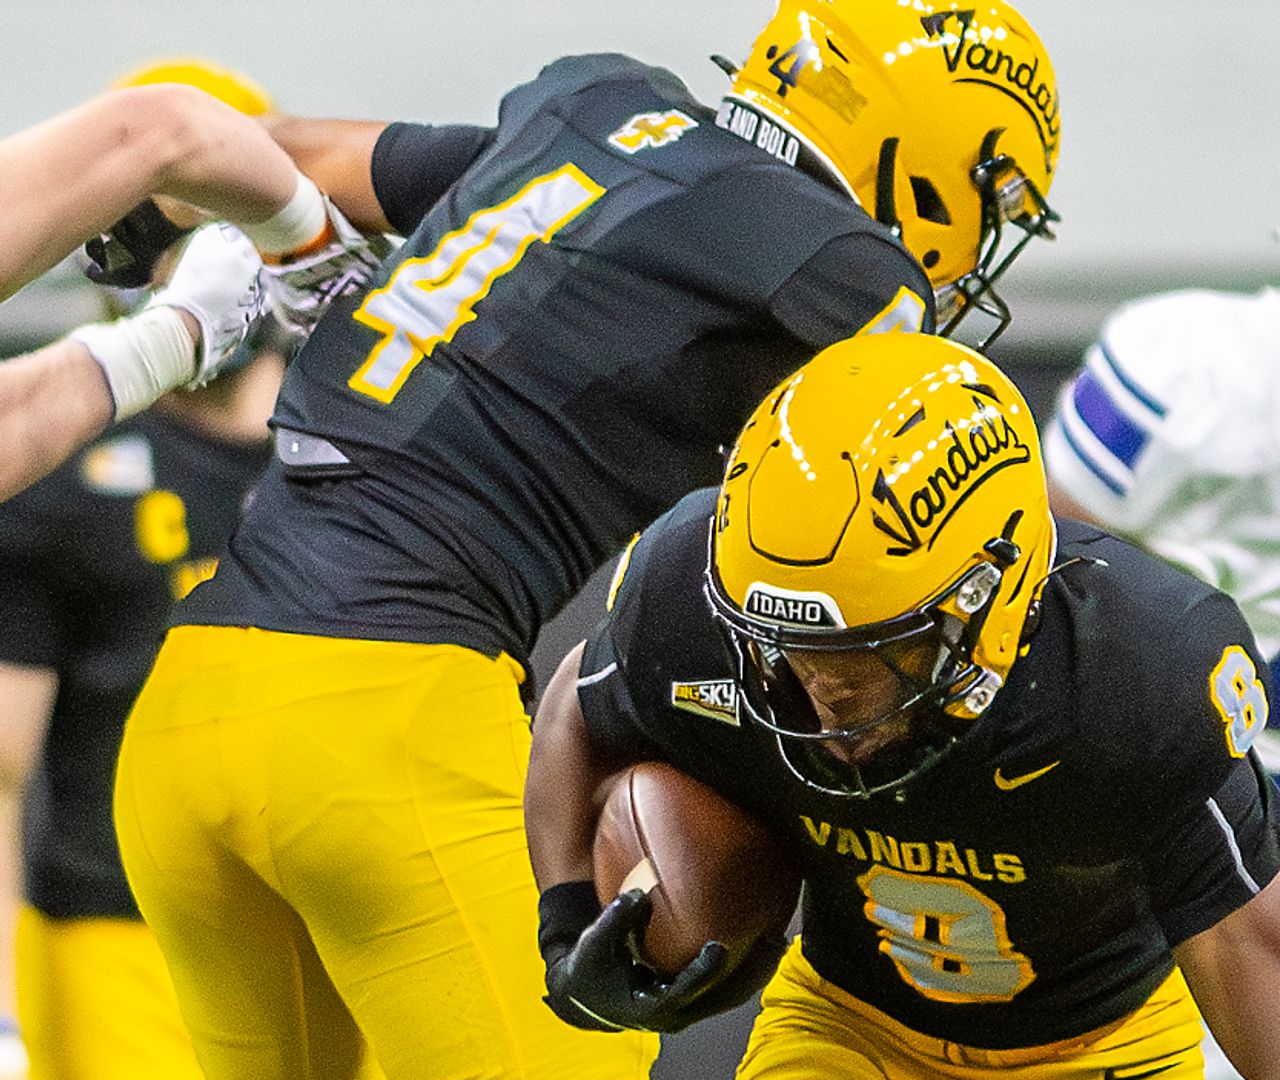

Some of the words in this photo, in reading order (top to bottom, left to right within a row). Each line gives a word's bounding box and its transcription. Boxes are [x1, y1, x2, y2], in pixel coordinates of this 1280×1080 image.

[757, 119, 800, 167] BOLD
[348, 162, 608, 404] 4
[871, 396, 1031, 558] Vandals
[753, 592, 822, 623] IDAHO
[1209, 645, 1269, 758] 8
[799, 815, 1028, 884] VANDALS
[856, 864, 1038, 1004] 8
